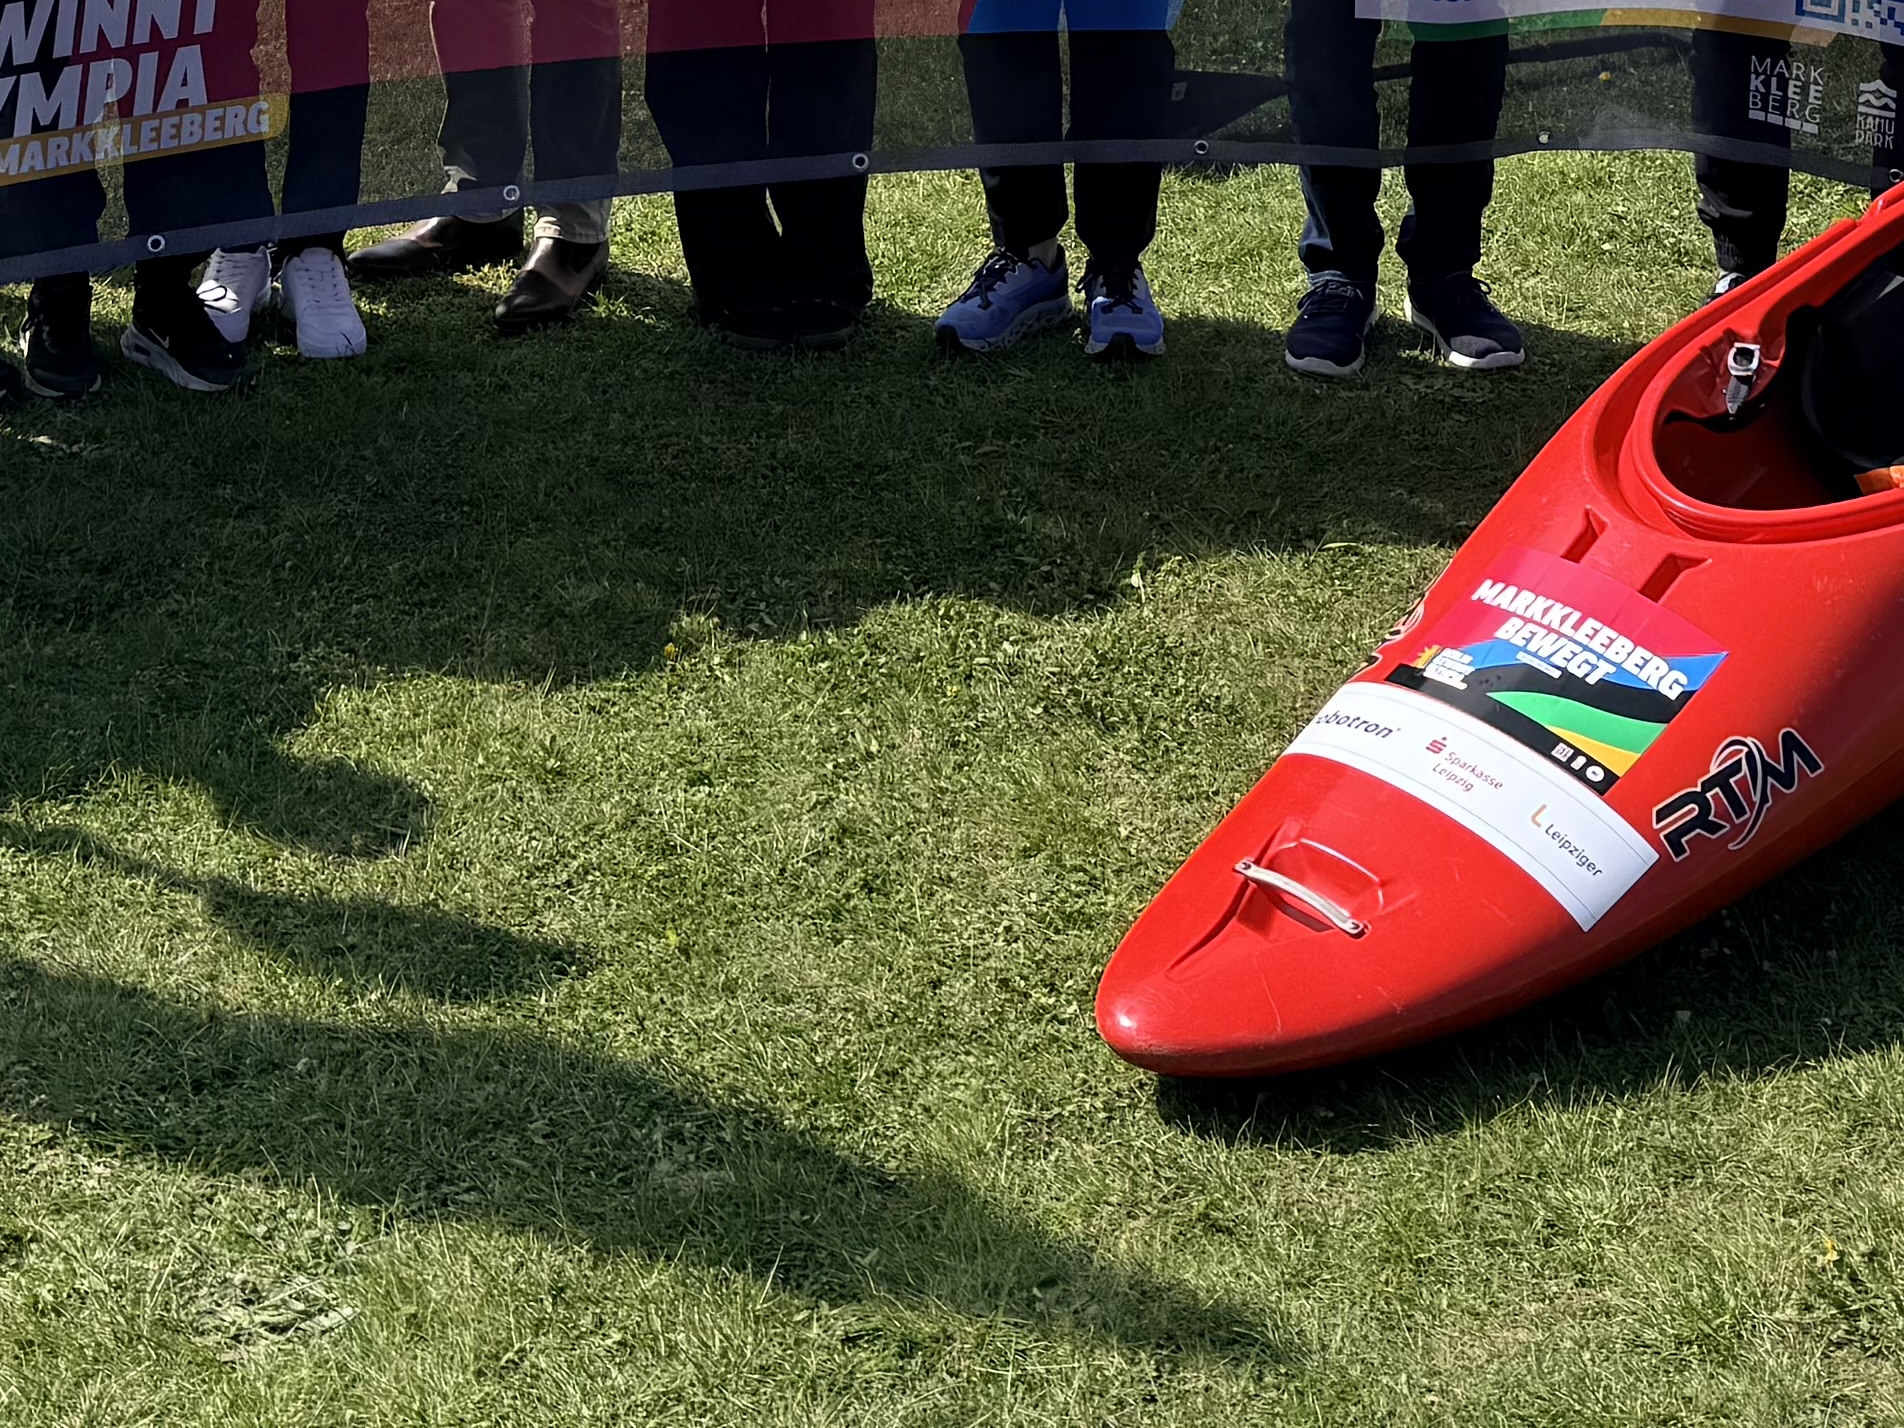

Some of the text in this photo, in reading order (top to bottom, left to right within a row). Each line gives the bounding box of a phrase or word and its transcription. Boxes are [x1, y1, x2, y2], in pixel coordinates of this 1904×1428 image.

[1750, 55, 1824, 86] MARK
[1748, 91, 1820, 124] BERG
[1750, 74, 1823, 105] KLEE
[1855, 130, 1894, 150] PARK
[1472, 577, 1686, 701] MARKKLEEBERG
[1497, 616, 1617, 688] BEWEGT
[1431, 762, 1476, 793] Leipzig
[1444, 751, 1504, 791] Sparkasse
[1652, 727, 1825, 862] RTM
[1543, 822, 1604, 878] Leipziger
